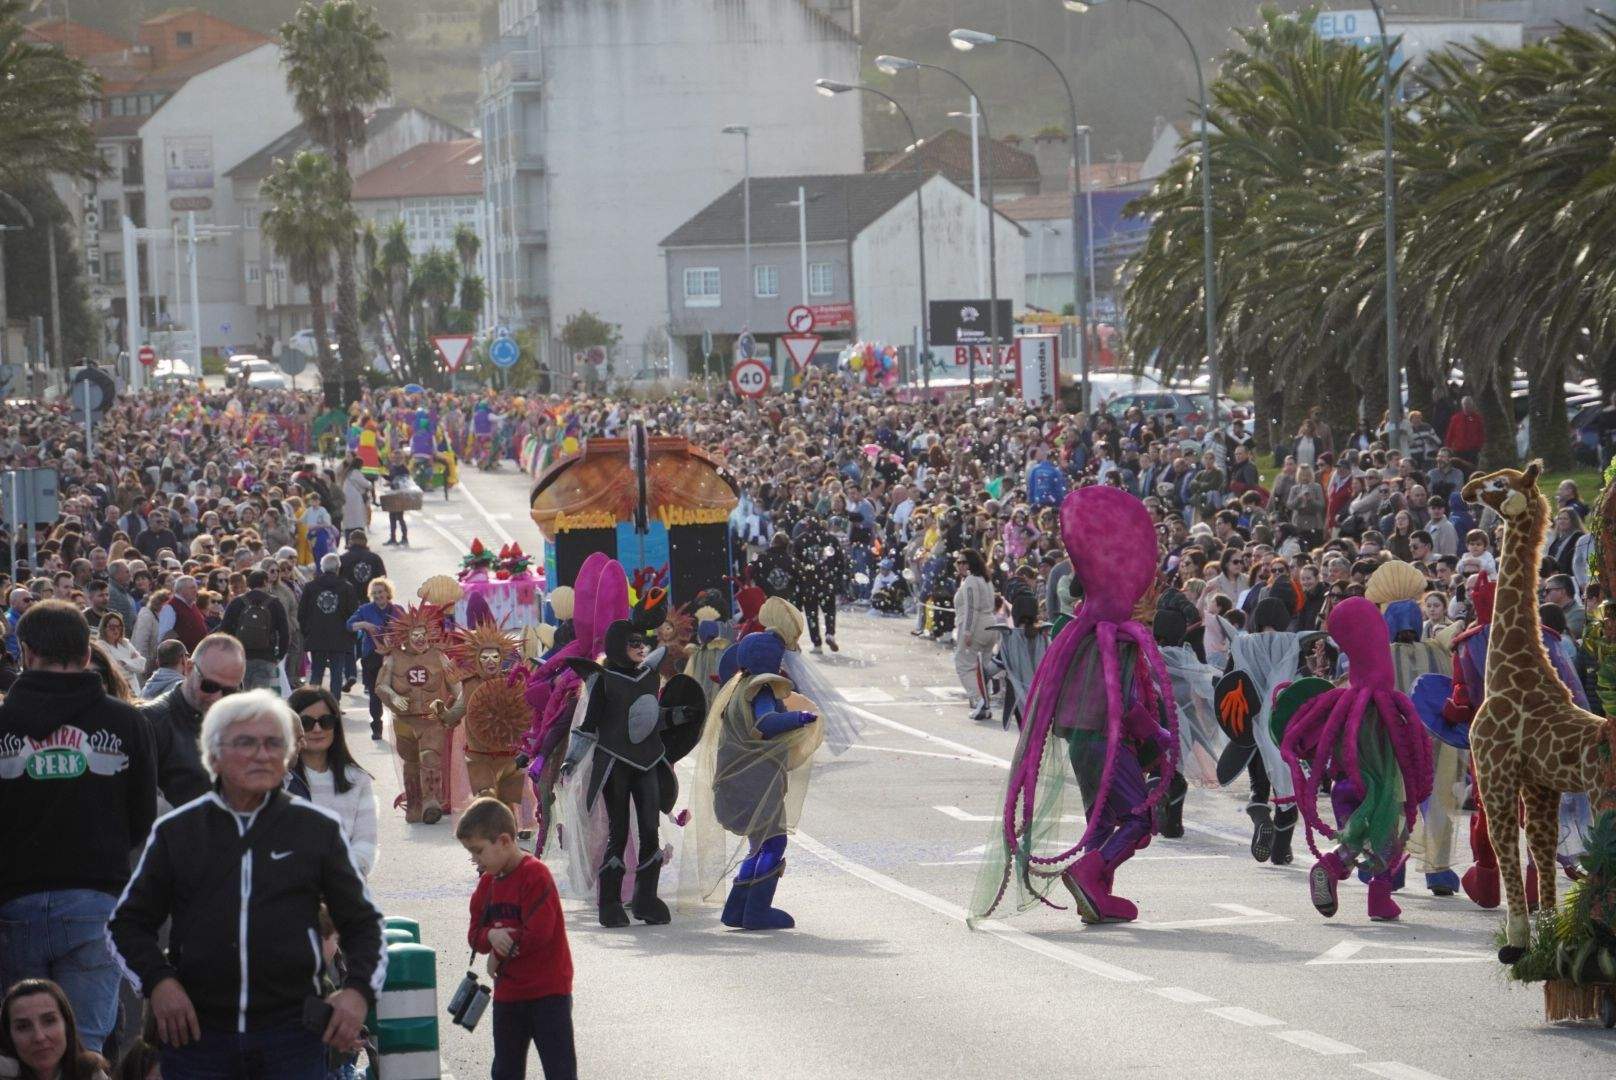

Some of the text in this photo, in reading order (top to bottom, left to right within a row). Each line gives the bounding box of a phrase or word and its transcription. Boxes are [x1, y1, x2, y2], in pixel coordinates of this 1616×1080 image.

[84, 194, 99, 277] HOTEL
[740, 372, 762, 385] 40
[409, 669, 426, 683] SE
[34, 754, 80, 775] PERK
